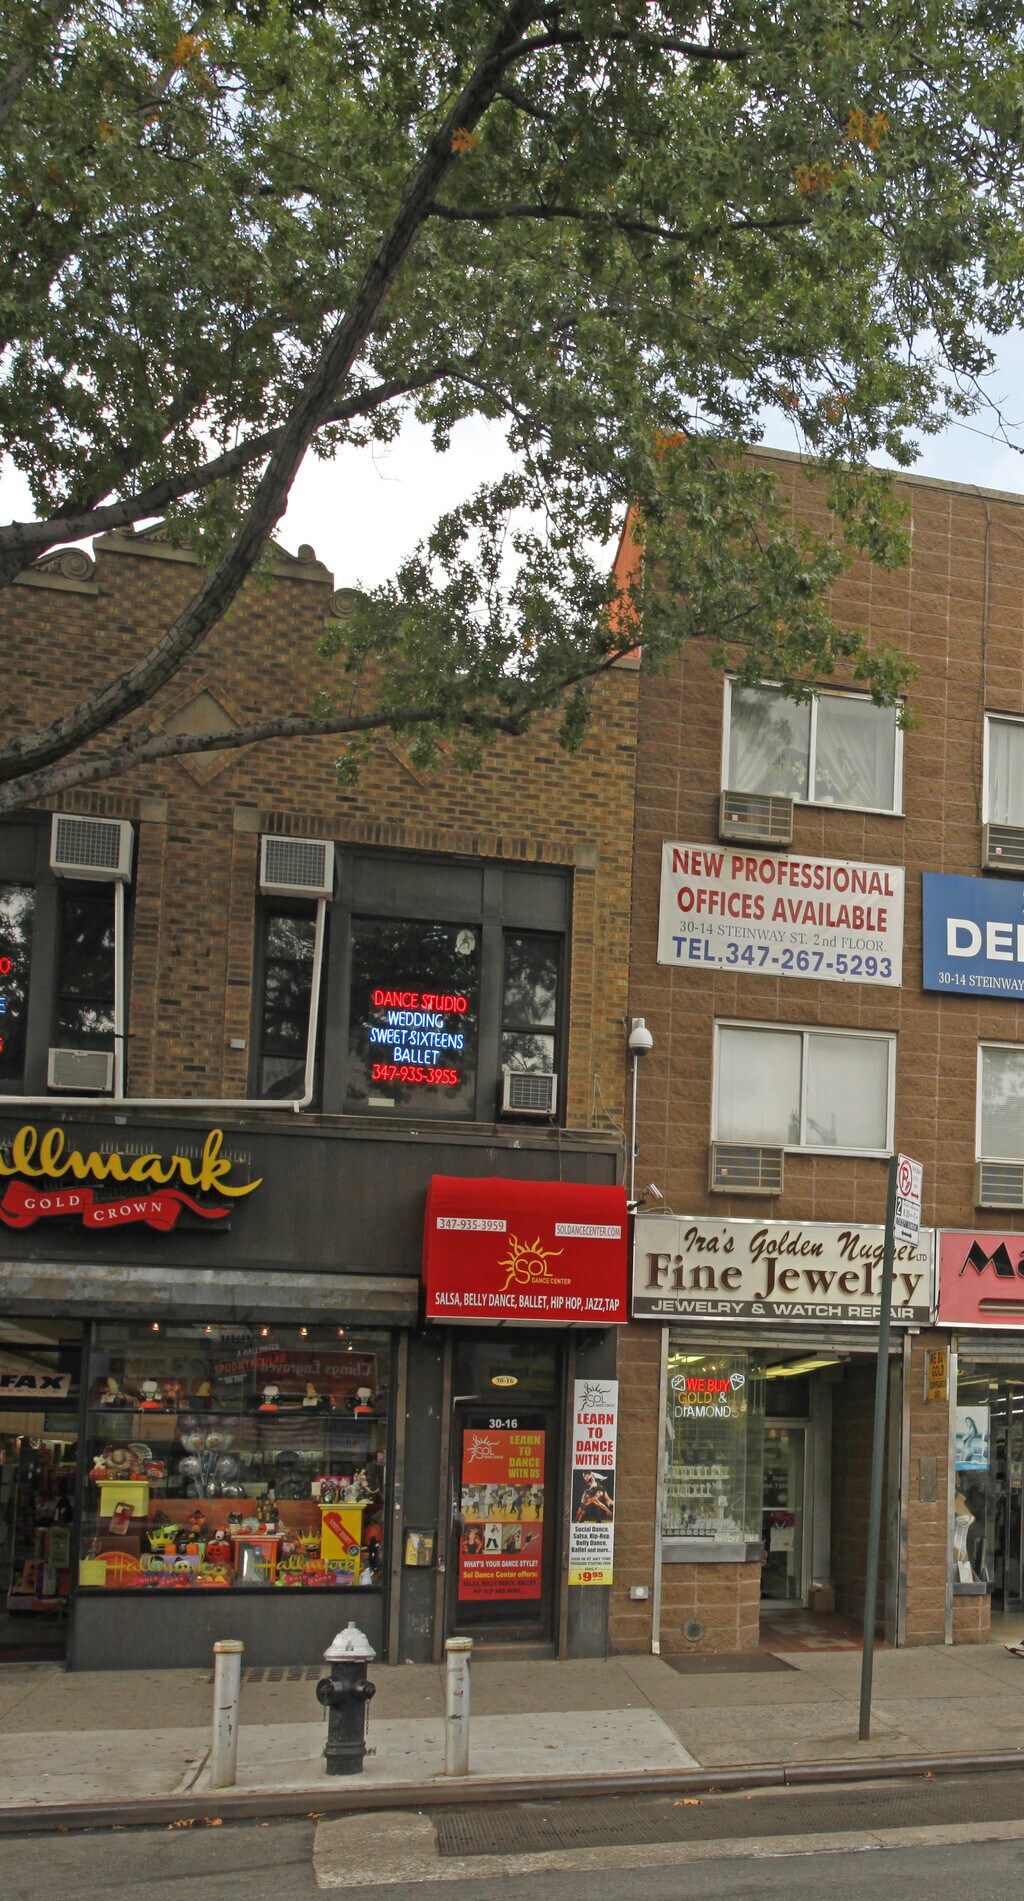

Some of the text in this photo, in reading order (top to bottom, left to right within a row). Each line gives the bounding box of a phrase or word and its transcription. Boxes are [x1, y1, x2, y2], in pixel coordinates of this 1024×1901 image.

[672, 848, 894, 897] NEW PROFESSIONAL
[677, 886, 888, 933] OFFICES AVAILABLE
[679, 920, 714, 935] 30-14
[717, 924, 786, 943] STEINWAY
[790, 932, 808, 945] ST.
[841, 937, 887, 953] FLOOR.
[672, 936, 892, 978] TEL.347-267-5293
[938, 971, 967, 987] 30-14
[969, 974, 1024, 992] STEINWAY
[373, 990, 468, 1013] DANCE STUDIO
[387, 1010, 444, 1028] WEDDING
[370, 1027, 464, 1049] SWEET SIXTEENS
[393, 1046, 440, 1065] BALLET
[371, 1064, 459, 1085] 347-935-3955
[0, 1125, 264, 1197] llmark
[24, 1195, 162, 1222] GOLD CROWN
[439, 1218, 621, 1238] 347-935-3959 SOLDANCECENTER.COM
[684, 1226, 917, 1268] Ira's Golden Nuget
[916, 1253, 927, 1261] LTD
[515, 1259, 553, 1284] SOL
[645, 1252, 743, 1291] Fine
[435, 1292, 462, 1307] SALSA,
[463, 1293, 487, 1306] BELLY
[489, 1294, 517, 1309] DANCE,
[519, 1295, 549, 1310] BALLET,
[551, 1296, 564, 1309] HIP
[565, 1297, 583, 1311] HOP,
[651, 1299, 745, 1314] JEWELRY
[751, 1302, 766, 1315] &
[773, 1303, 842, 1317] WATCH
[0, 1374, 65, 1389] FAX
[687, 1378, 730, 1392] WE BUY
[678, 1391, 727, 1404] GOLD &
[489, 1419, 518, 1429] 30-16
[577, 1413, 614, 1425] LEARN
[509, 1435, 541, 1445] LEARN
[587, 1427, 603, 1439] TO
[518, 1446, 532, 1456] TO
[576, 1440, 613, 1452] DANCE
[509, 1457, 541, 1467] DANCE
[575, 1454, 613, 1466] WITH US
[508, 1468, 540, 1478] WITH US
